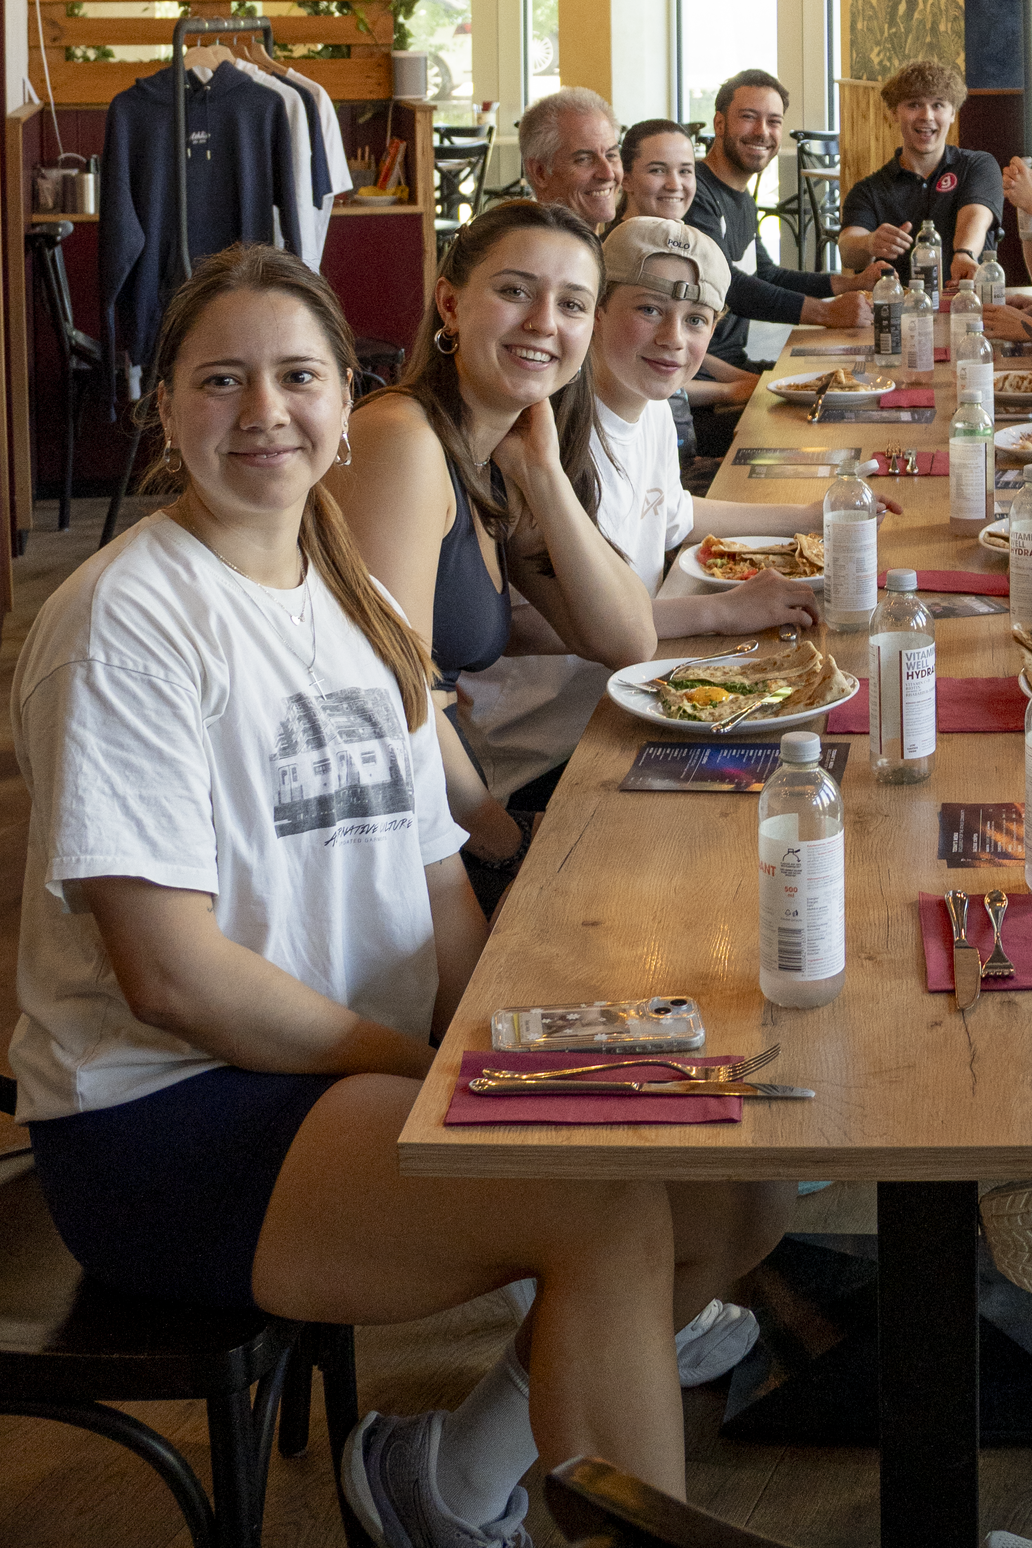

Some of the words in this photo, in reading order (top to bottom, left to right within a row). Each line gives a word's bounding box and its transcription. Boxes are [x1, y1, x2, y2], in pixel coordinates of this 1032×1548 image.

[667, 238, 691, 250] POLO
[905, 659, 930, 671] WELL
[906, 664, 935, 680] HYDRA
[784, 885, 798, 893] 500
